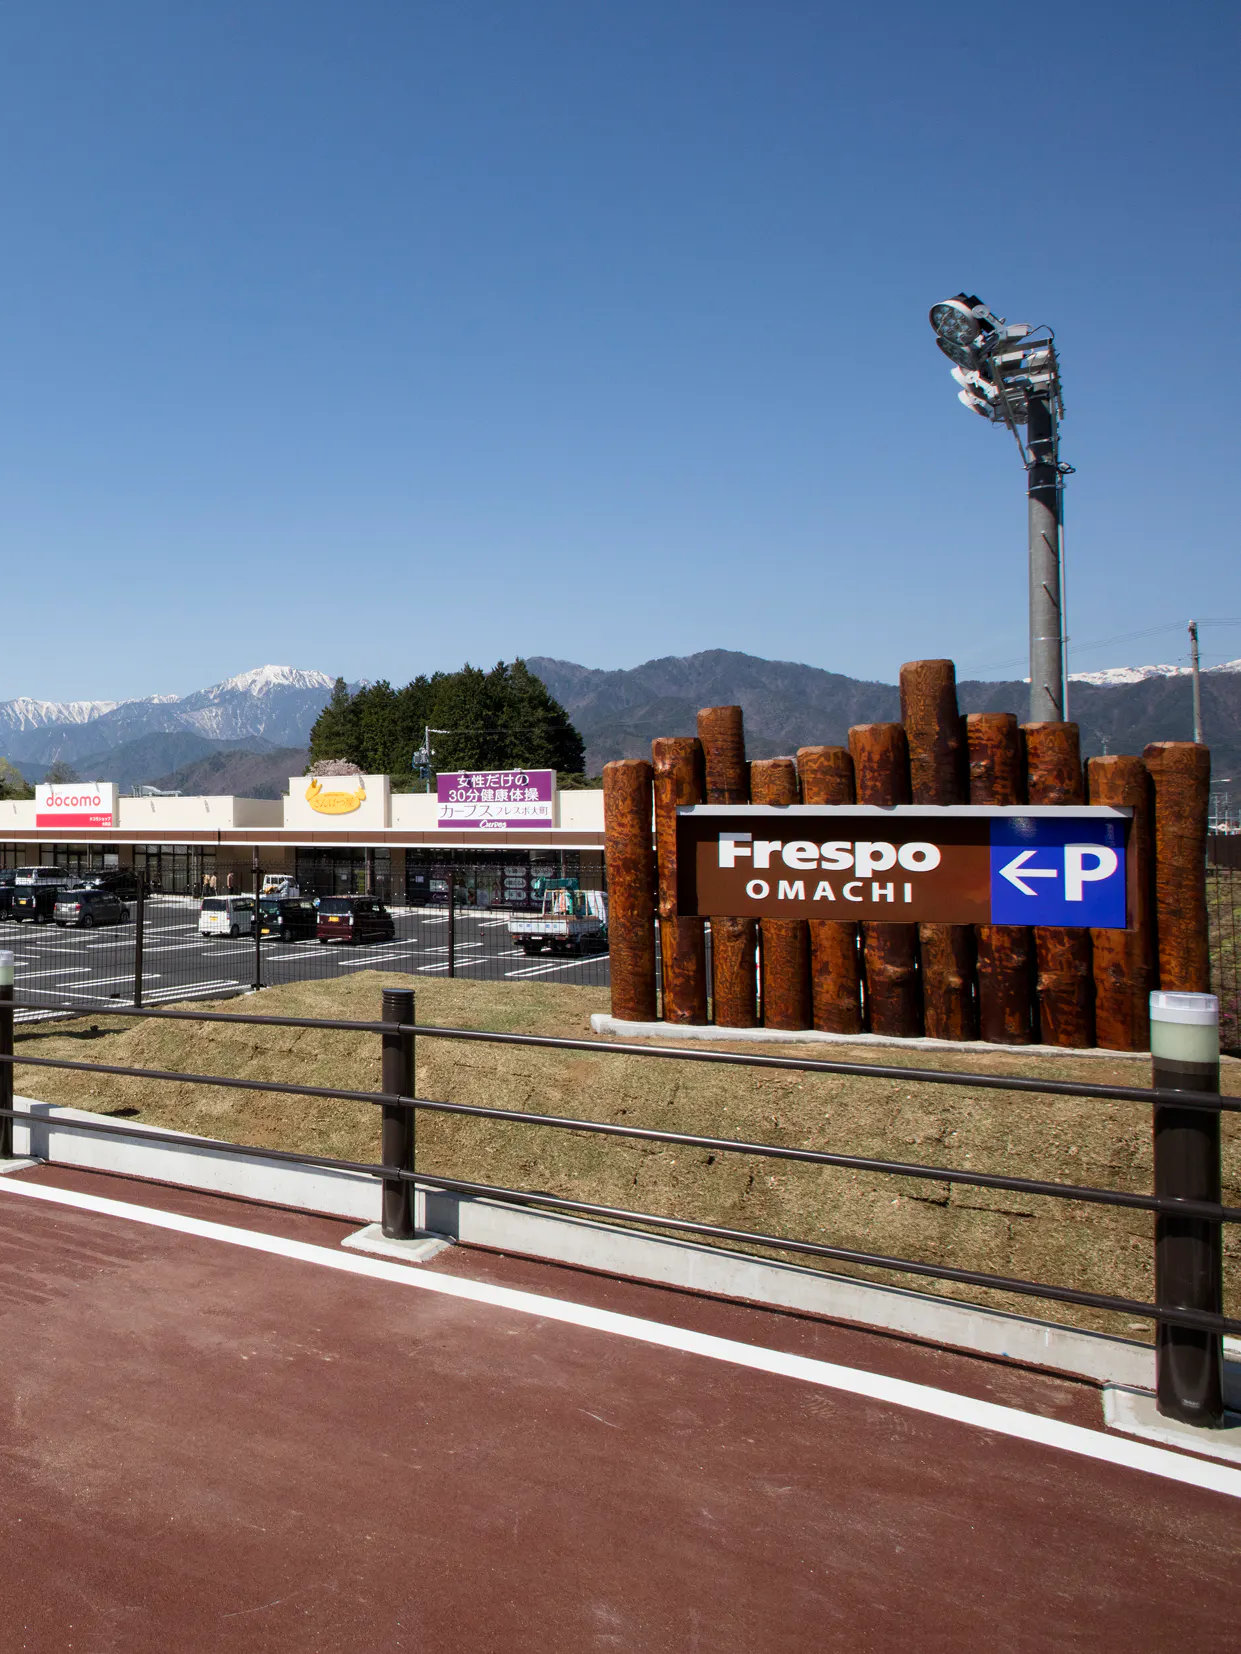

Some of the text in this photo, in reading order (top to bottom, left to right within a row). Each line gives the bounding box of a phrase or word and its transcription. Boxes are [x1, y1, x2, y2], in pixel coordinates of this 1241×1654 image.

[457, 774, 530, 788] 女性だけの
[46, 793, 101, 807] docomo
[448, 788, 539, 802] 30分健康体操
[479, 819, 507, 829] Curves
[718, 833, 941, 878] Frespo
[1064, 843, 1118, 902] P
[745, 878, 913, 903] OMACHI
